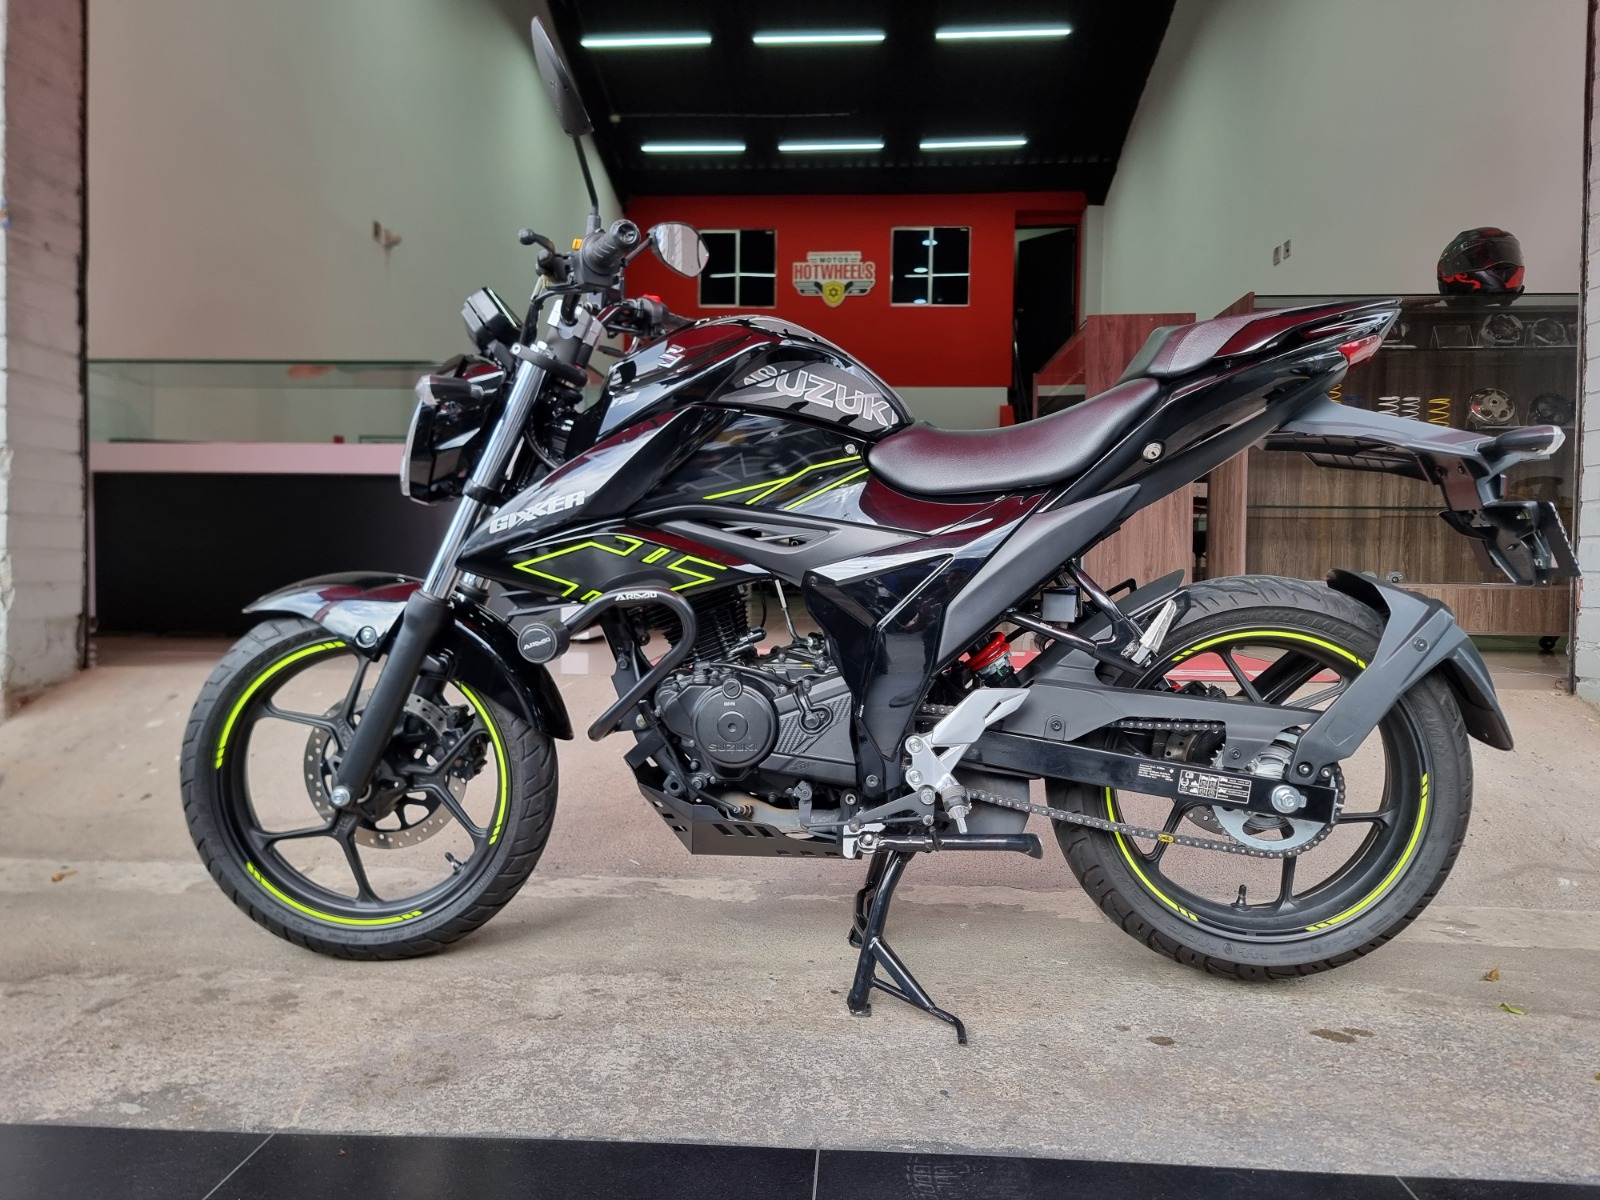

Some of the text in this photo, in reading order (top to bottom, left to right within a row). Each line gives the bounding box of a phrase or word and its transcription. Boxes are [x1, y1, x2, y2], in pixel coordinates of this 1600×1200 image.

[794, 263, 874, 280] HOTWHEELS
[488, 490, 587, 534] GIXXER
[708, 742, 758, 752] SUZUKI
